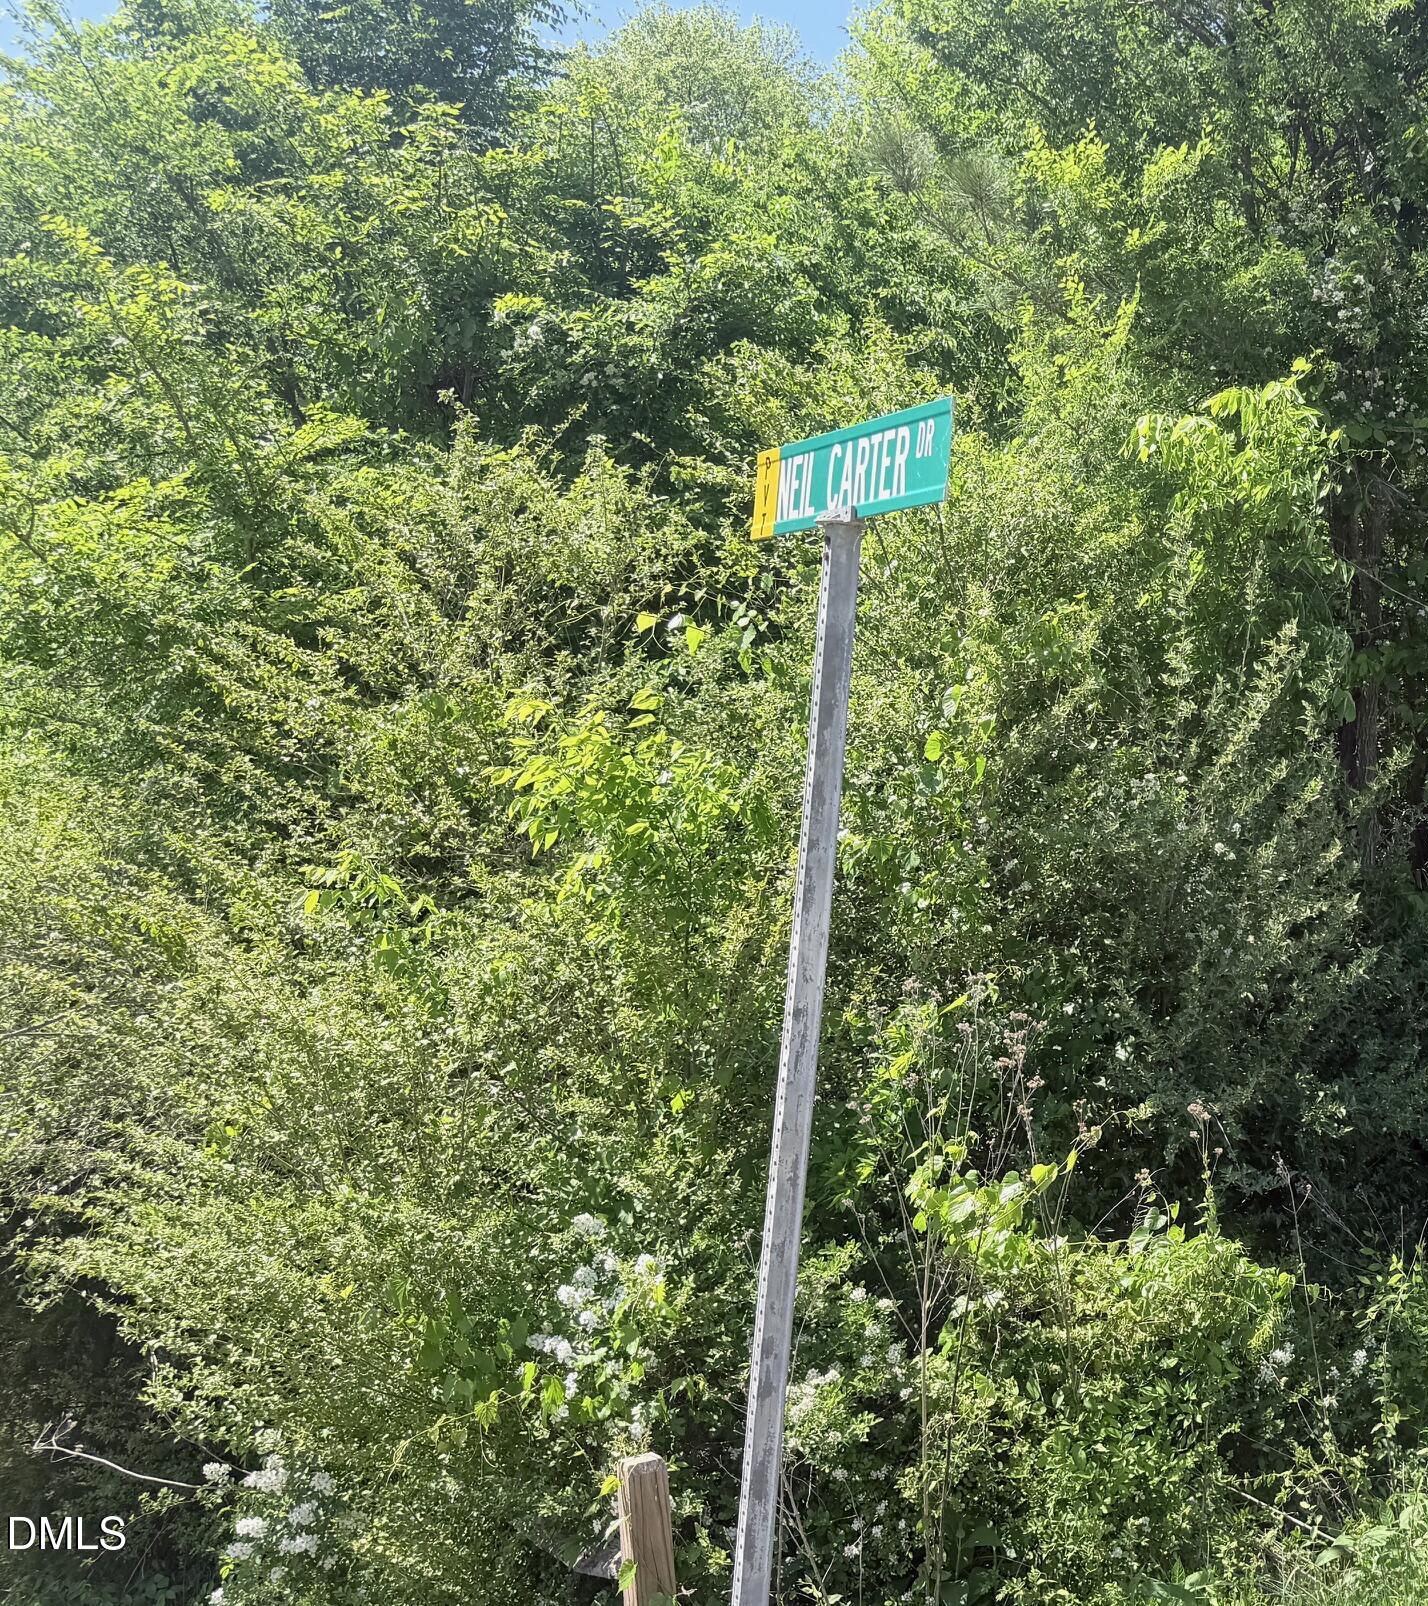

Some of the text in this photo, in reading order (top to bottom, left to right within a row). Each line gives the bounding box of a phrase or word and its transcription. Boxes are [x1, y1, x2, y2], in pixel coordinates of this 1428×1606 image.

[761, 456, 771, 536] PVT
[777, 418, 935, 522] NEIL CARTER DR
